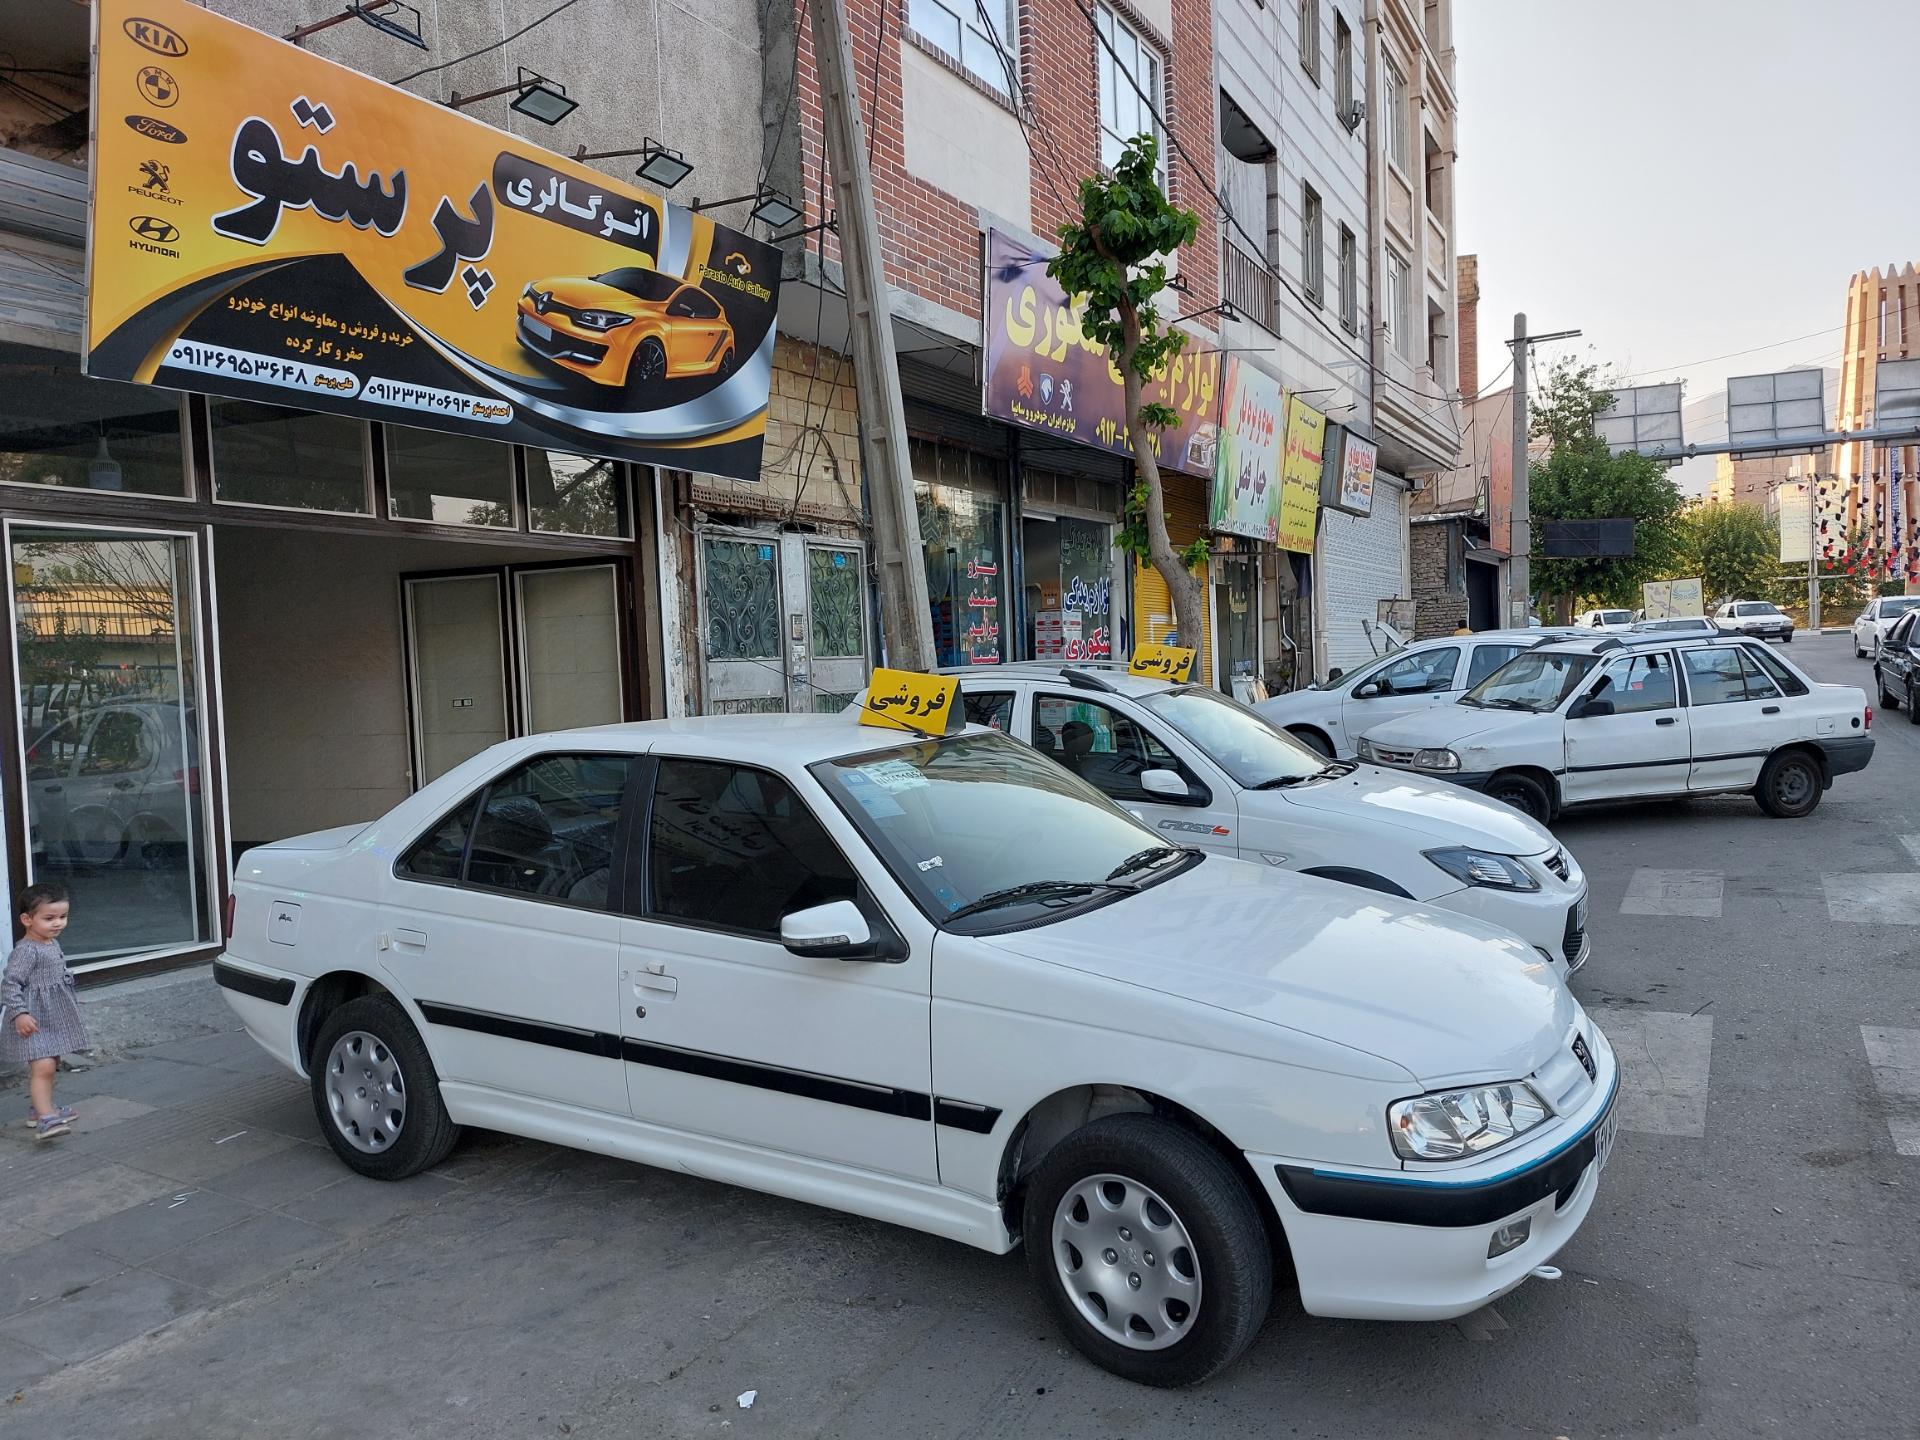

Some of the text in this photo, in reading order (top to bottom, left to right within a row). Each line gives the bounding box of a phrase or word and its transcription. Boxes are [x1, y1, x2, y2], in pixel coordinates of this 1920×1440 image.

[135, 22, 178, 53] KIA
[137, 118, 177, 141] Ford
[128, 186, 184, 206] PEUGEOT
[211, 94, 497, 312] پرستو
[129, 240, 180, 259] HYUNDAI
[698, 263, 771, 302] Parasto Auto Gallery
[228, 296, 414, 347] خرید و فروش و معاوضه انواع خودرو
[172, 346, 308, 385] ۰۹۱۲۶۹۵۳۶۴۸
[335, 349, 341, 360] و
[344, 346, 364, 362] صفر
[314, 374, 354, 390] علی پرستو
[1170, 347, 1216, 416] لوازم
[368, 383, 471, 413] ۰۹۱۲۳۳۲۰۶۹۴
[472, 402, 510, 418] احمد پرستو
[1011, 399, 1025, 417] سایپا
[1030, 409, 1047, 424] خودرو
[1048, 412, 1062, 428] ایران
[1062, 417, 1076, 433] لوازم
[967, 555, 997, 584] پژو
[968, 588, 998, 607] سمند
[1064, 575, 1110, 618] لوازم یدکی
[969, 619, 998, 644] پراید
[1064, 625, 1111, 661] شکوری
[1133, 651, 1190, 675] فروشی
[869, 684, 947, 717] فروشی
